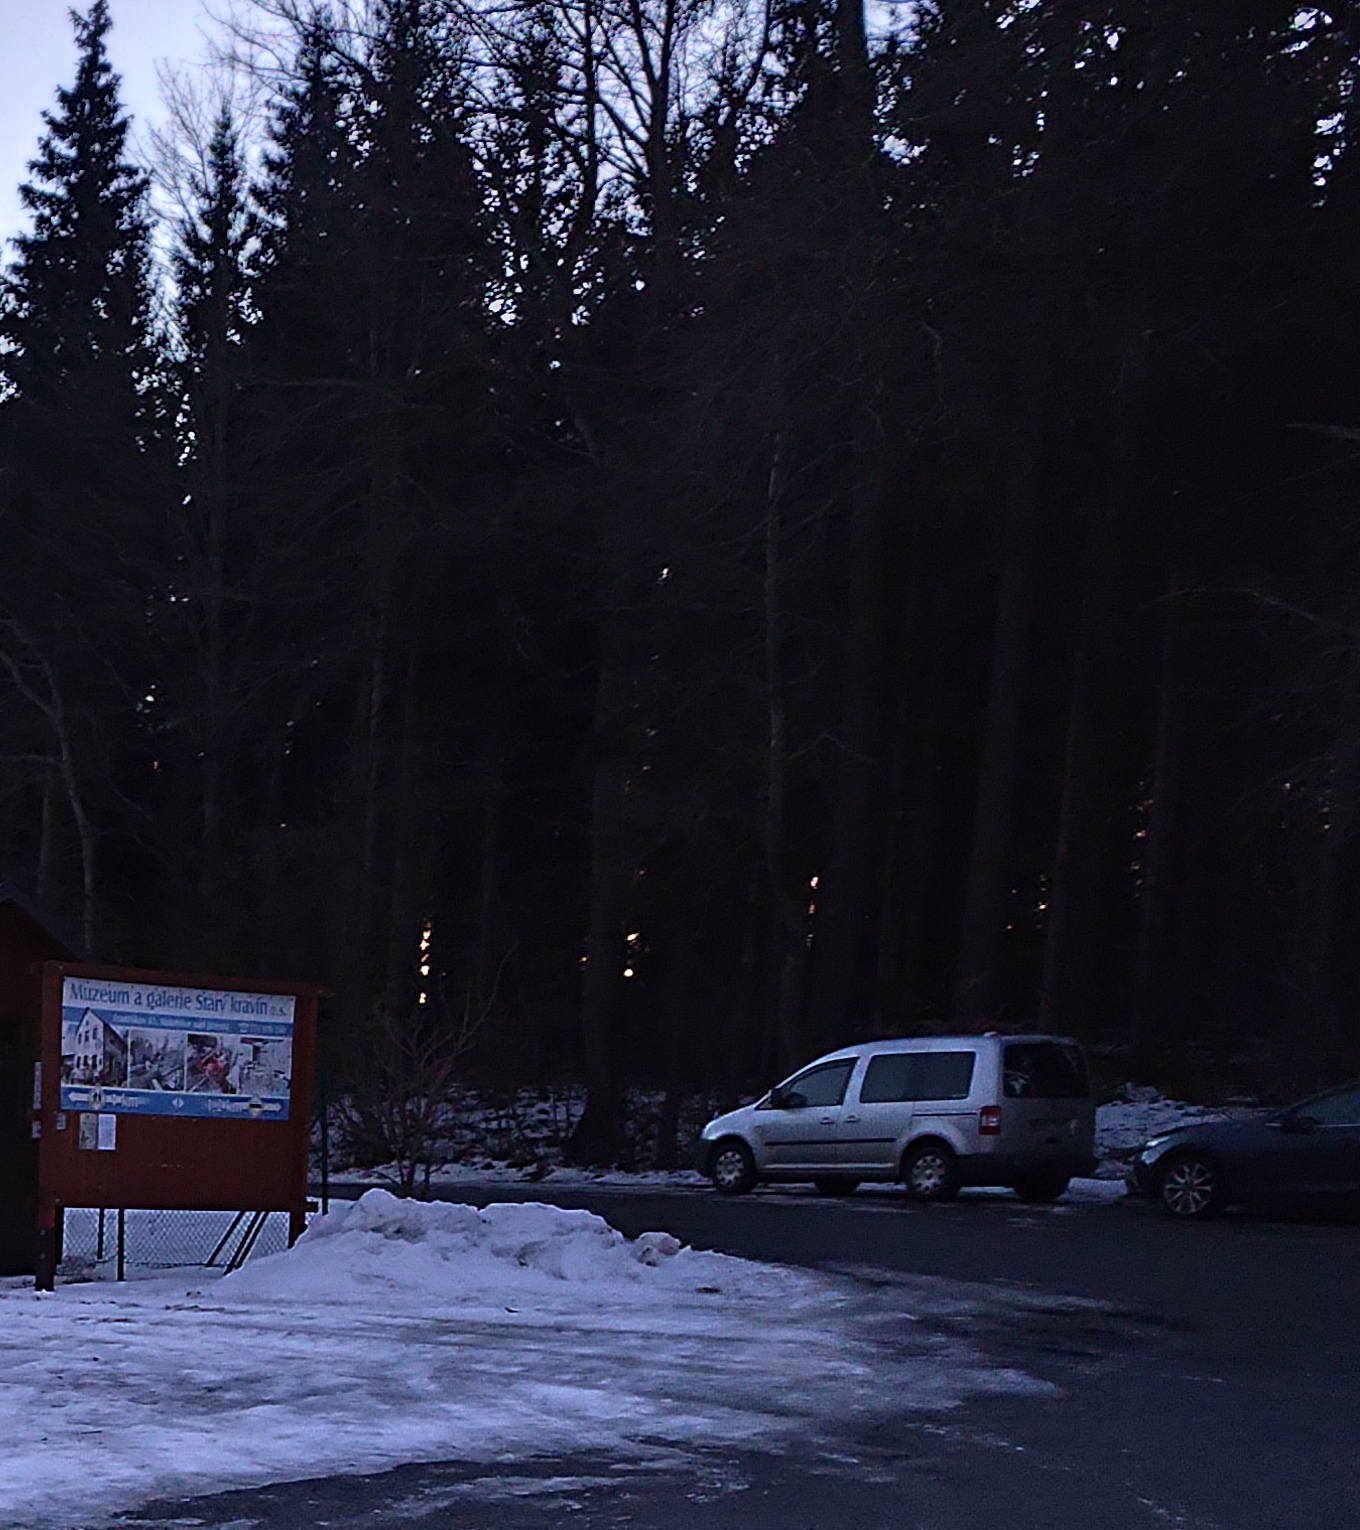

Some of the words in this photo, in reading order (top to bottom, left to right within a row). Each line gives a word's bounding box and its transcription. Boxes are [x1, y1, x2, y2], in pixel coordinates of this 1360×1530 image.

[70, 982, 130, 1001] Muzeum
[133, 991, 142, 1006] a
[146, 987, 192, 1010] galerie
